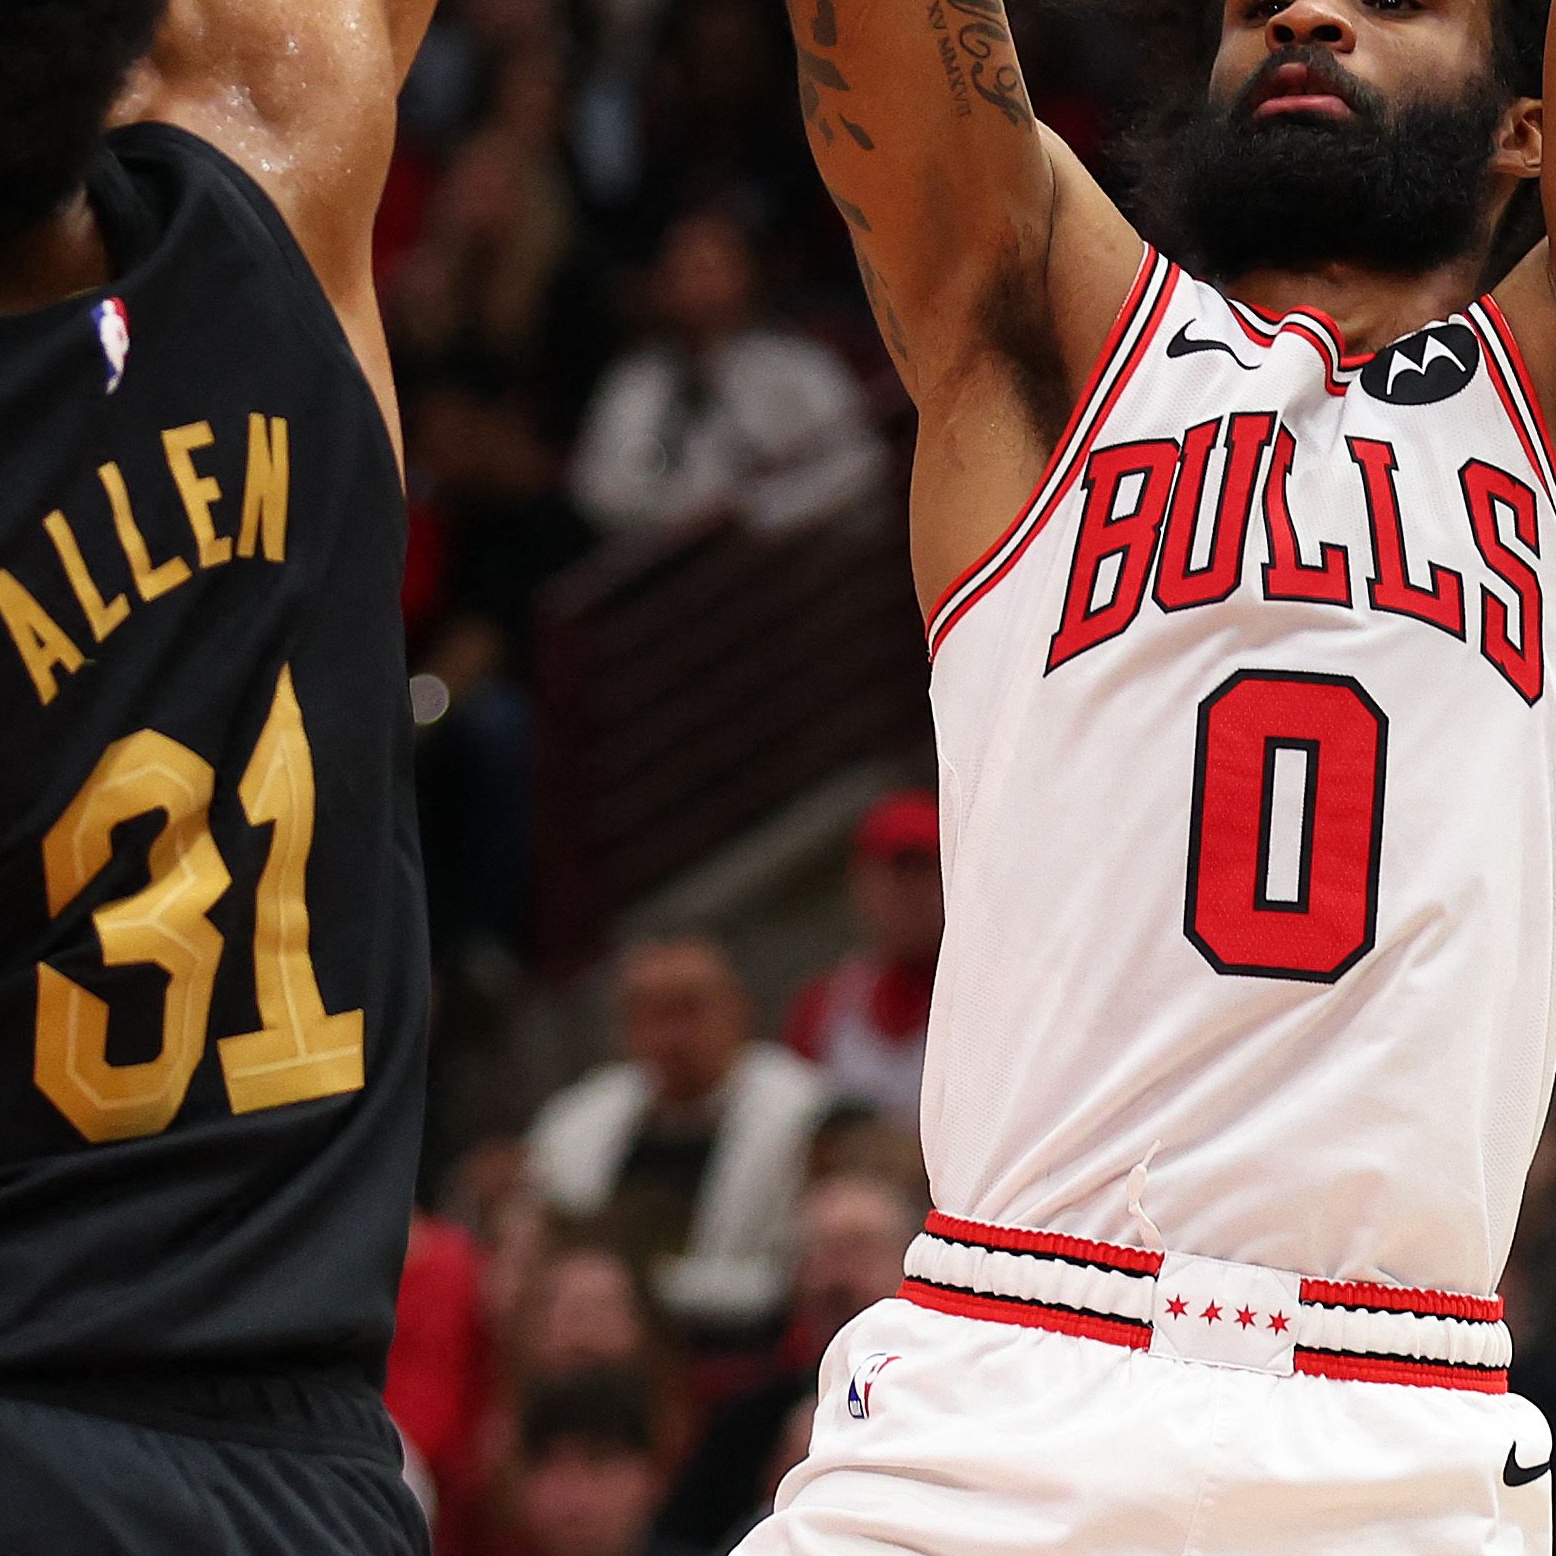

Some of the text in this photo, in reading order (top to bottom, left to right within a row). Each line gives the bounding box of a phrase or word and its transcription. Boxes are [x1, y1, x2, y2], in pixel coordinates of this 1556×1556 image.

[1043, 411, 1545, 708] BULLS
[33, 660, 365, 1143] 31
[1183, 668, 1390, 984] 0
